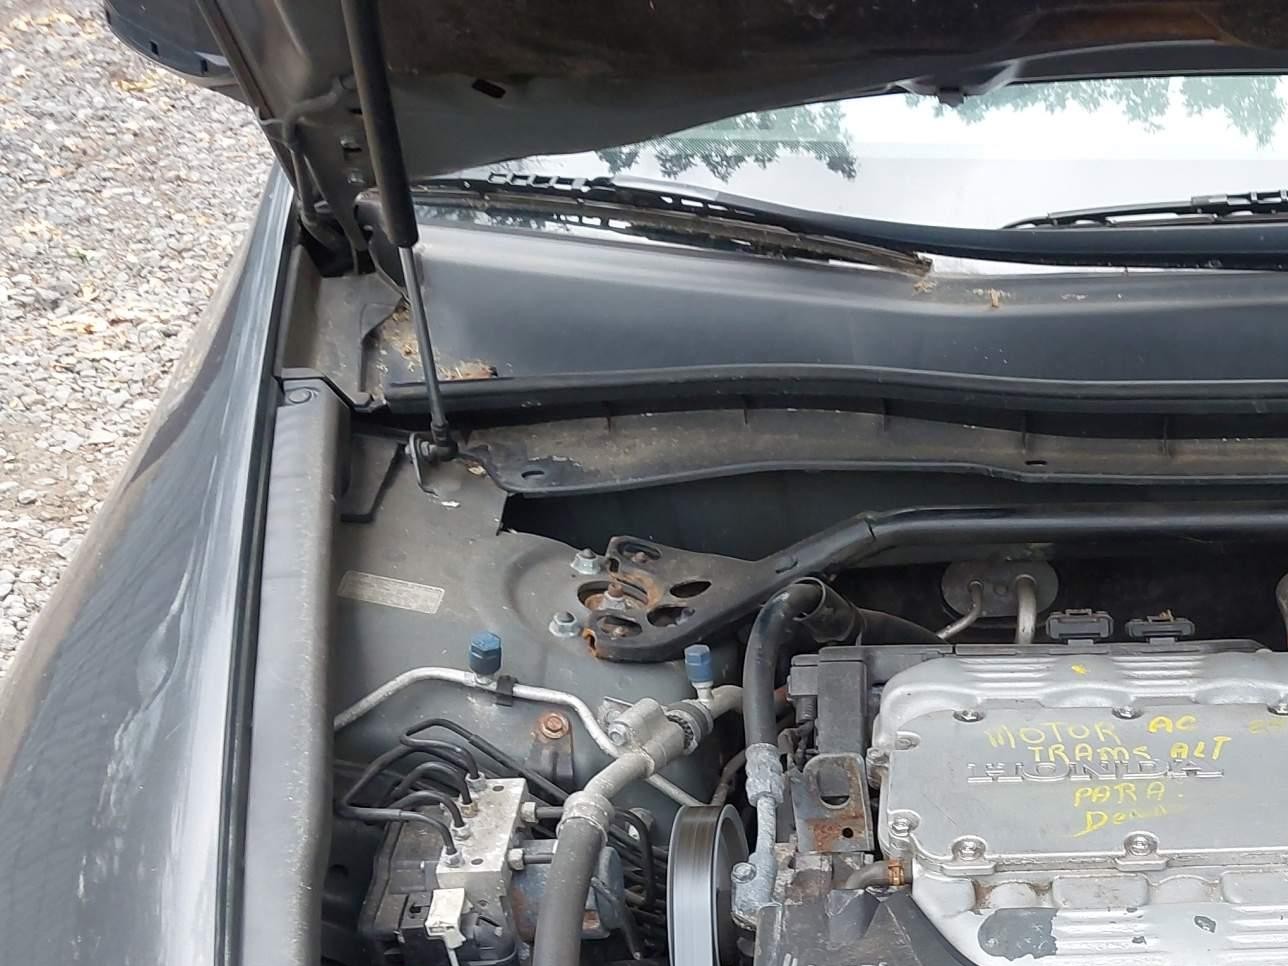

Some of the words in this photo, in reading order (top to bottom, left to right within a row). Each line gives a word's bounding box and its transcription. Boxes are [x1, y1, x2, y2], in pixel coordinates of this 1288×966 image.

[985, 721, 1121, 749] MOTOR
[1147, 714, 1197, 734] AC
[1170, 735, 1232, 761] ALT
[967, 757, 1225, 783] HONDA
[1073, 782, 1166, 807] PARA
